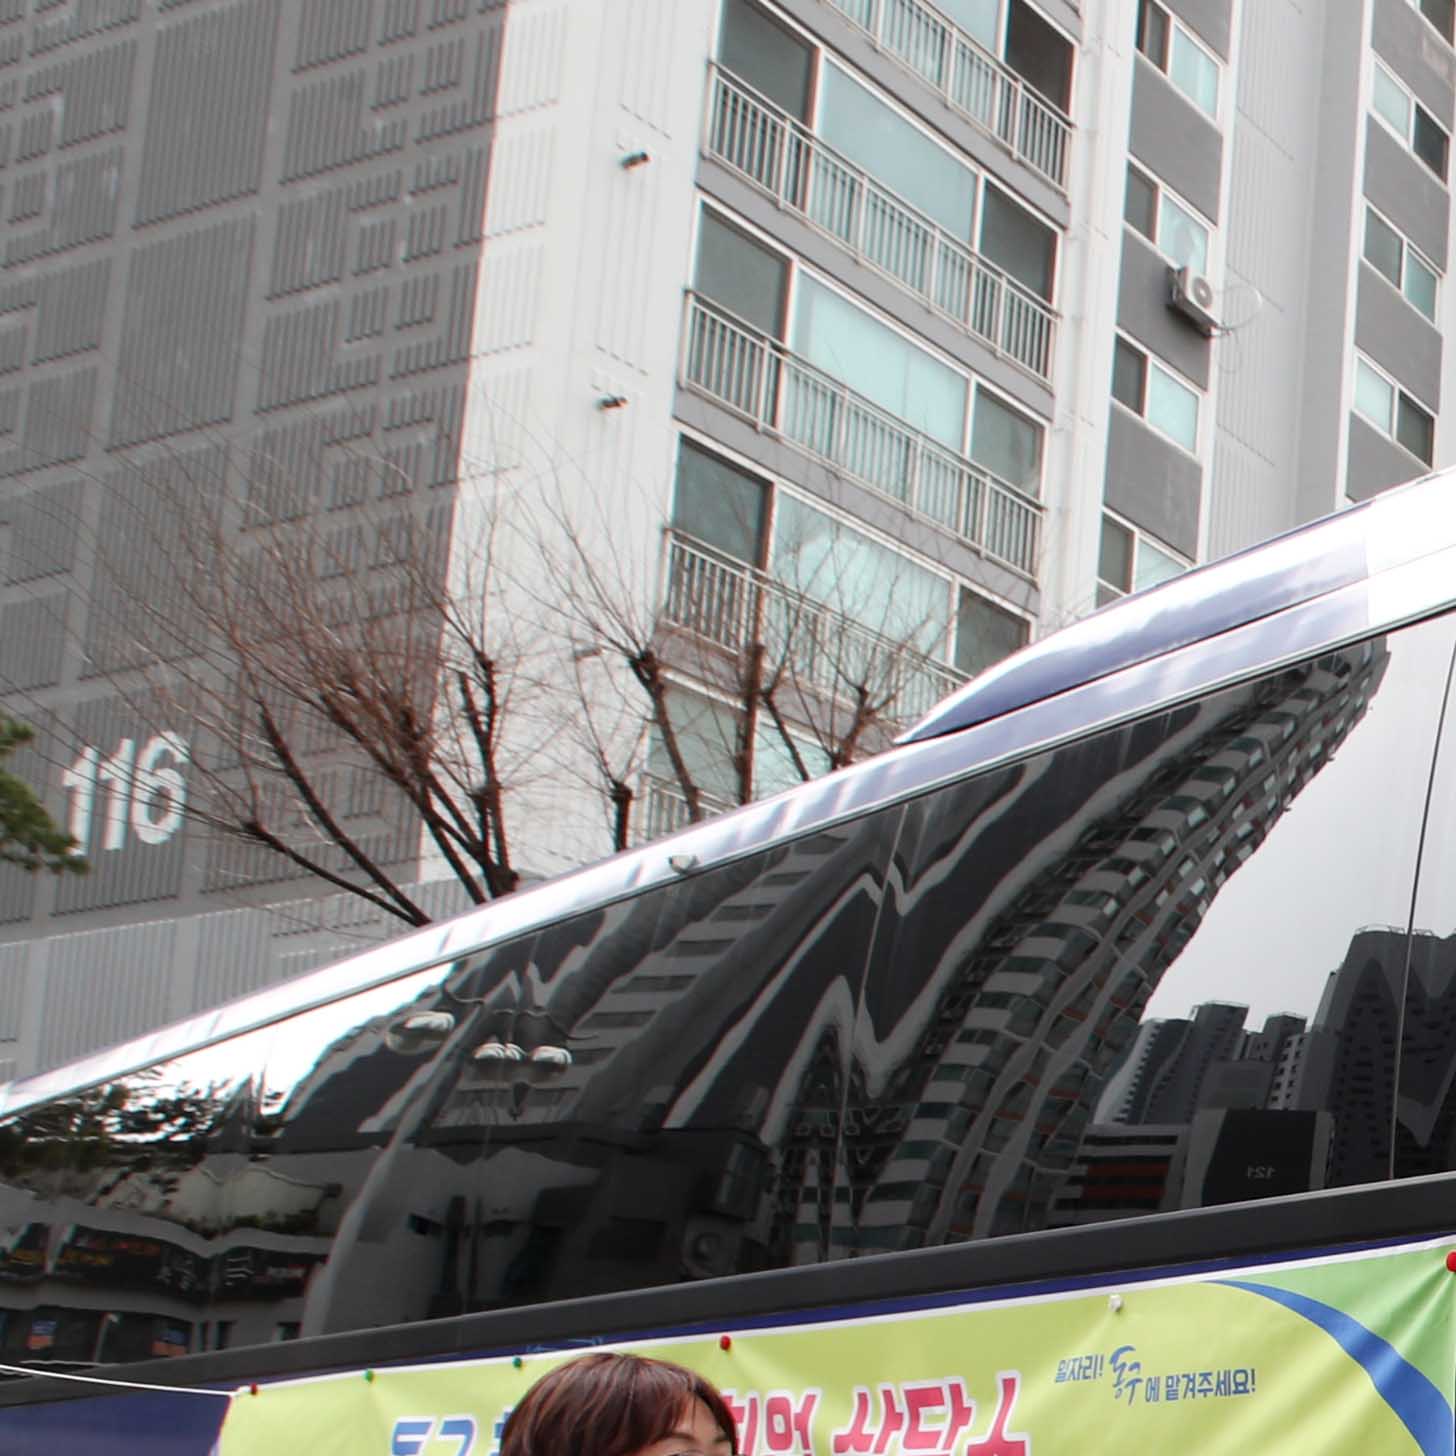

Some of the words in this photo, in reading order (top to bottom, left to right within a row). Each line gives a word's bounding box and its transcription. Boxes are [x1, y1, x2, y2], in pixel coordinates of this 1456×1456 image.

[62, 731, 191, 858] 116
[1055, 1353, 1105, 1383] 일자리!
[1109, 1344, 1144, 1406] 동구
[1165, 1368, 1256, 1402] 맡겨주세요!
